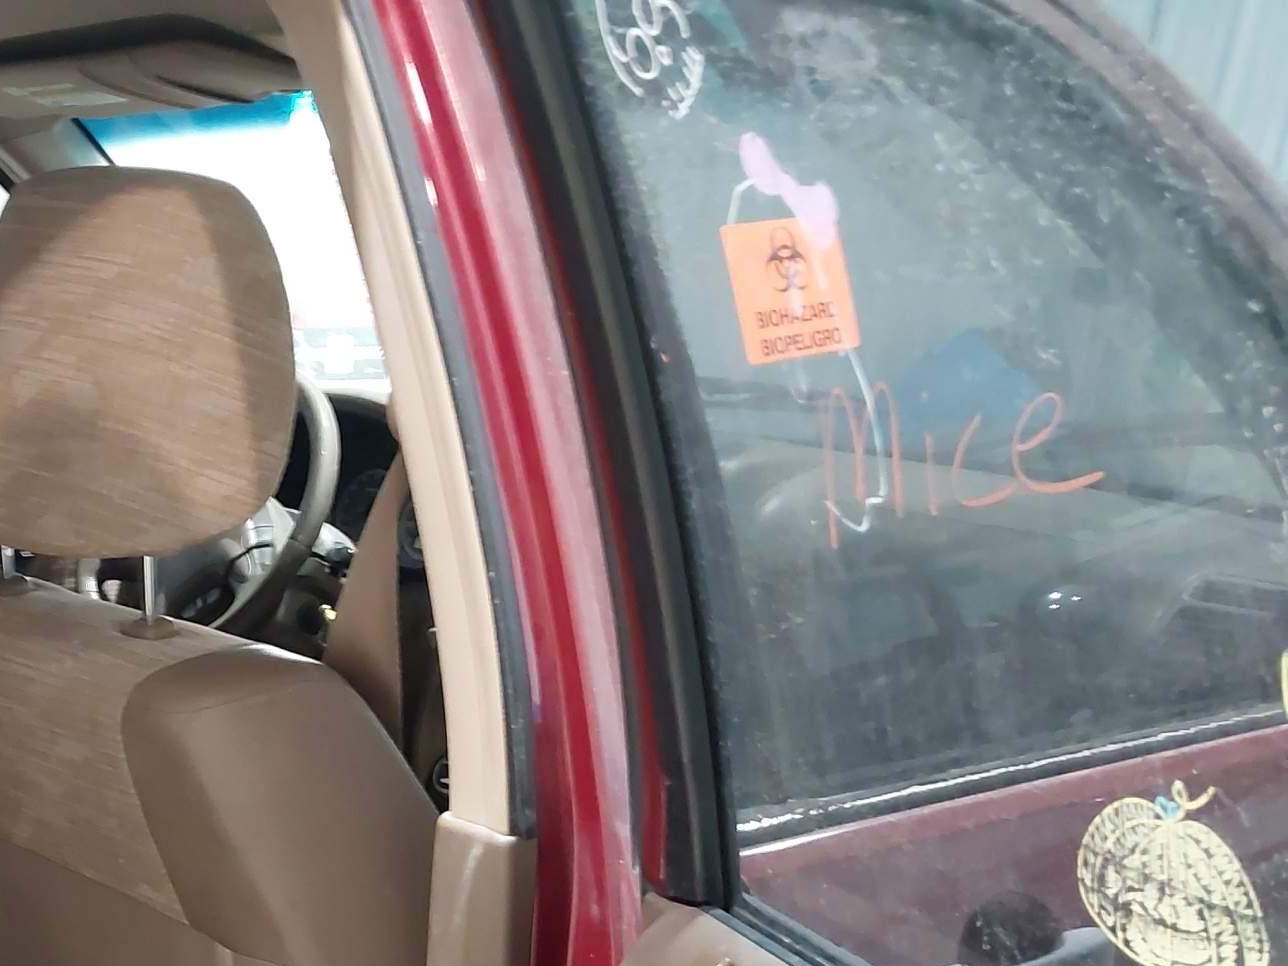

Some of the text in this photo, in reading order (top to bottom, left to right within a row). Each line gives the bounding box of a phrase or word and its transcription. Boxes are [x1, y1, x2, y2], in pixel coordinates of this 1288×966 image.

[754, 300, 836, 329] BIOHAZARD
[760, 328, 842, 357] BIOPELIGRO
[824, 380, 1104, 550] Mice
